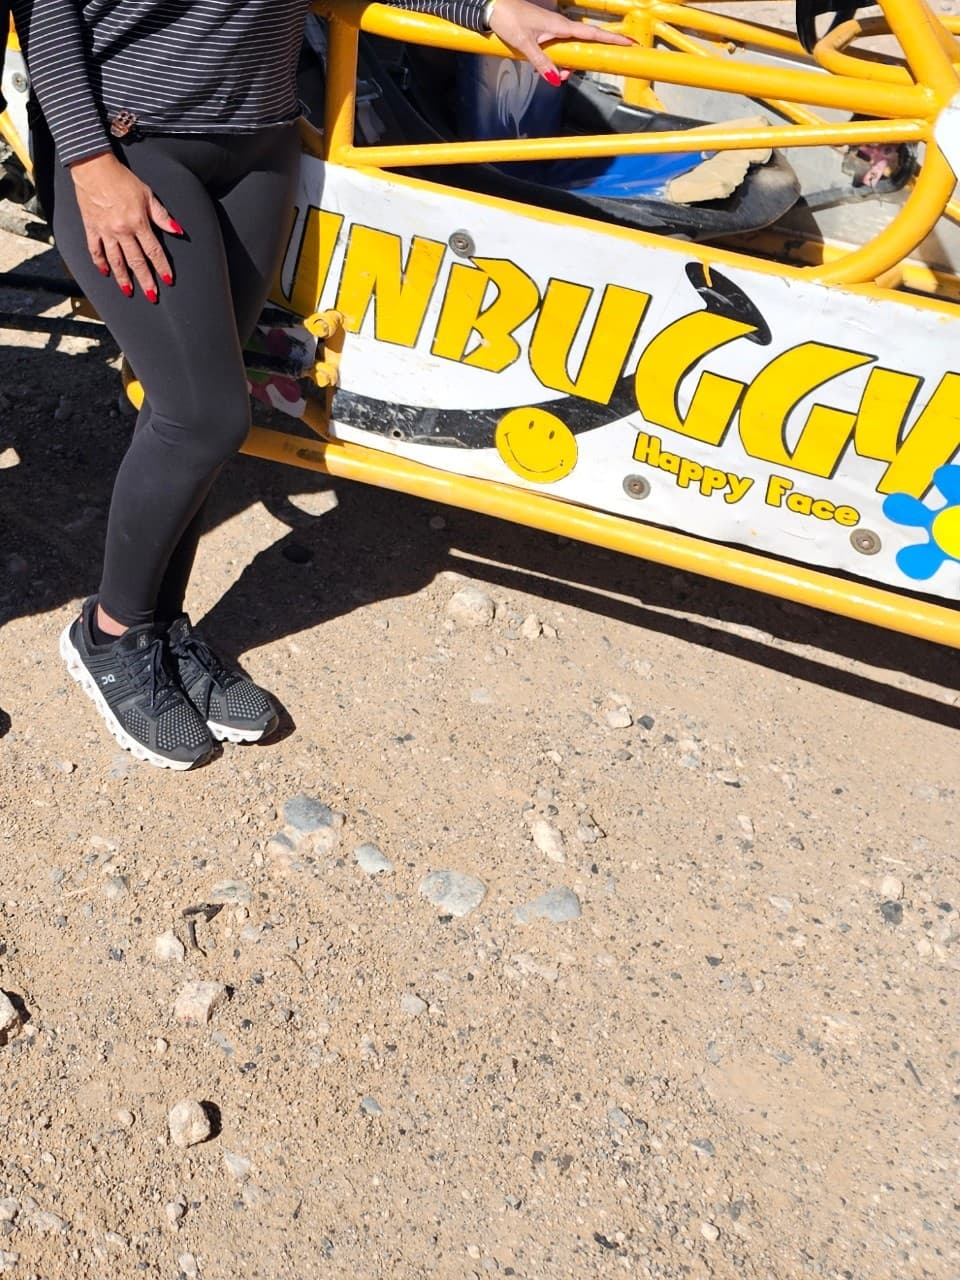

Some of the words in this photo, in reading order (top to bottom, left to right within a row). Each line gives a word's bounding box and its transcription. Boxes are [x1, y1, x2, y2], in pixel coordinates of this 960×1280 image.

[266, 204, 960, 501] UNBUGGY
[632, 431, 754, 504] Happy
[764, 474, 861, 527] Face
